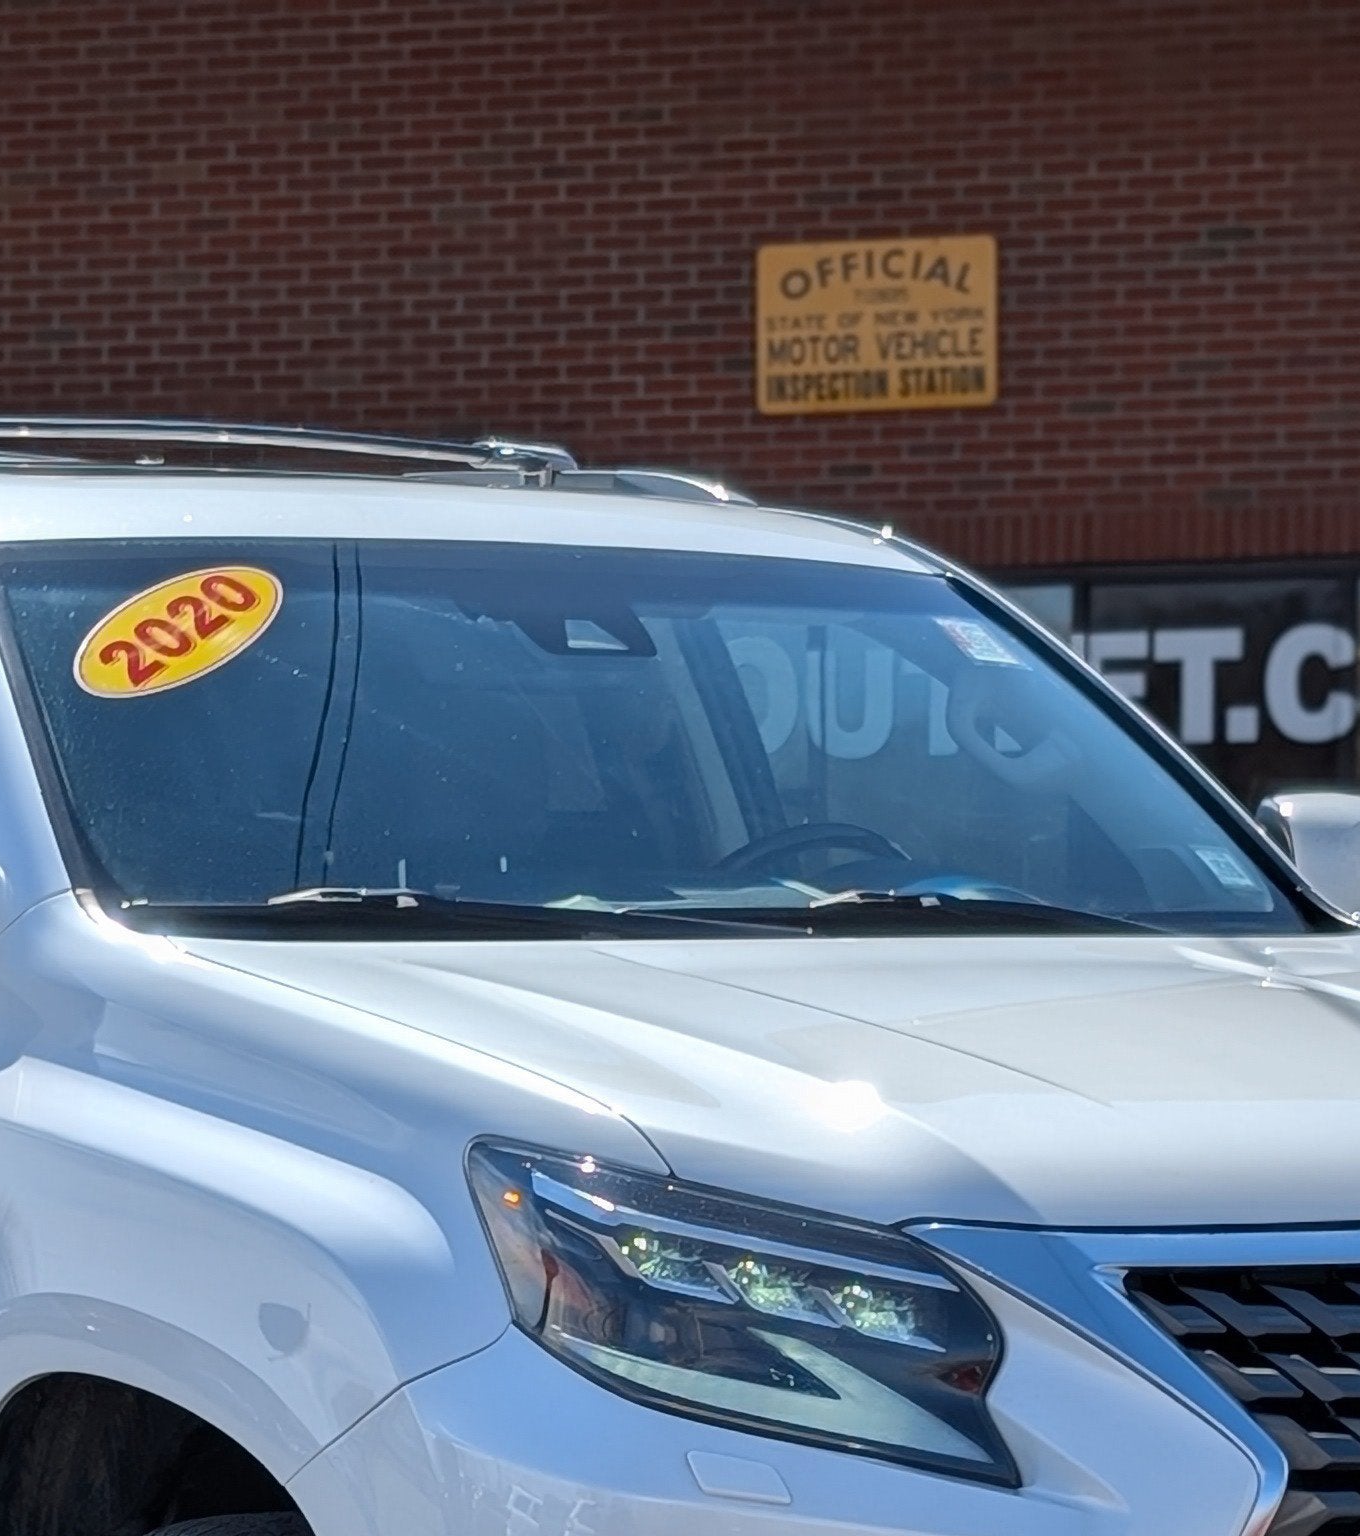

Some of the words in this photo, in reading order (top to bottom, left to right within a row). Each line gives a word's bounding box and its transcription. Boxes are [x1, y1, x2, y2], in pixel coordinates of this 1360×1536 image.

[780, 248, 971, 300] OFFICIAL
[766, 312, 826, 332] STATE
[837, 311, 864, 328] OF
[766, 335, 860, 366] MOTOR
[876, 328, 984, 361] VEHICLE
[766, 369, 889, 403] INSPECTION
[899, 365, 986, 398] STATION
[98, 574, 262, 688] 2020
